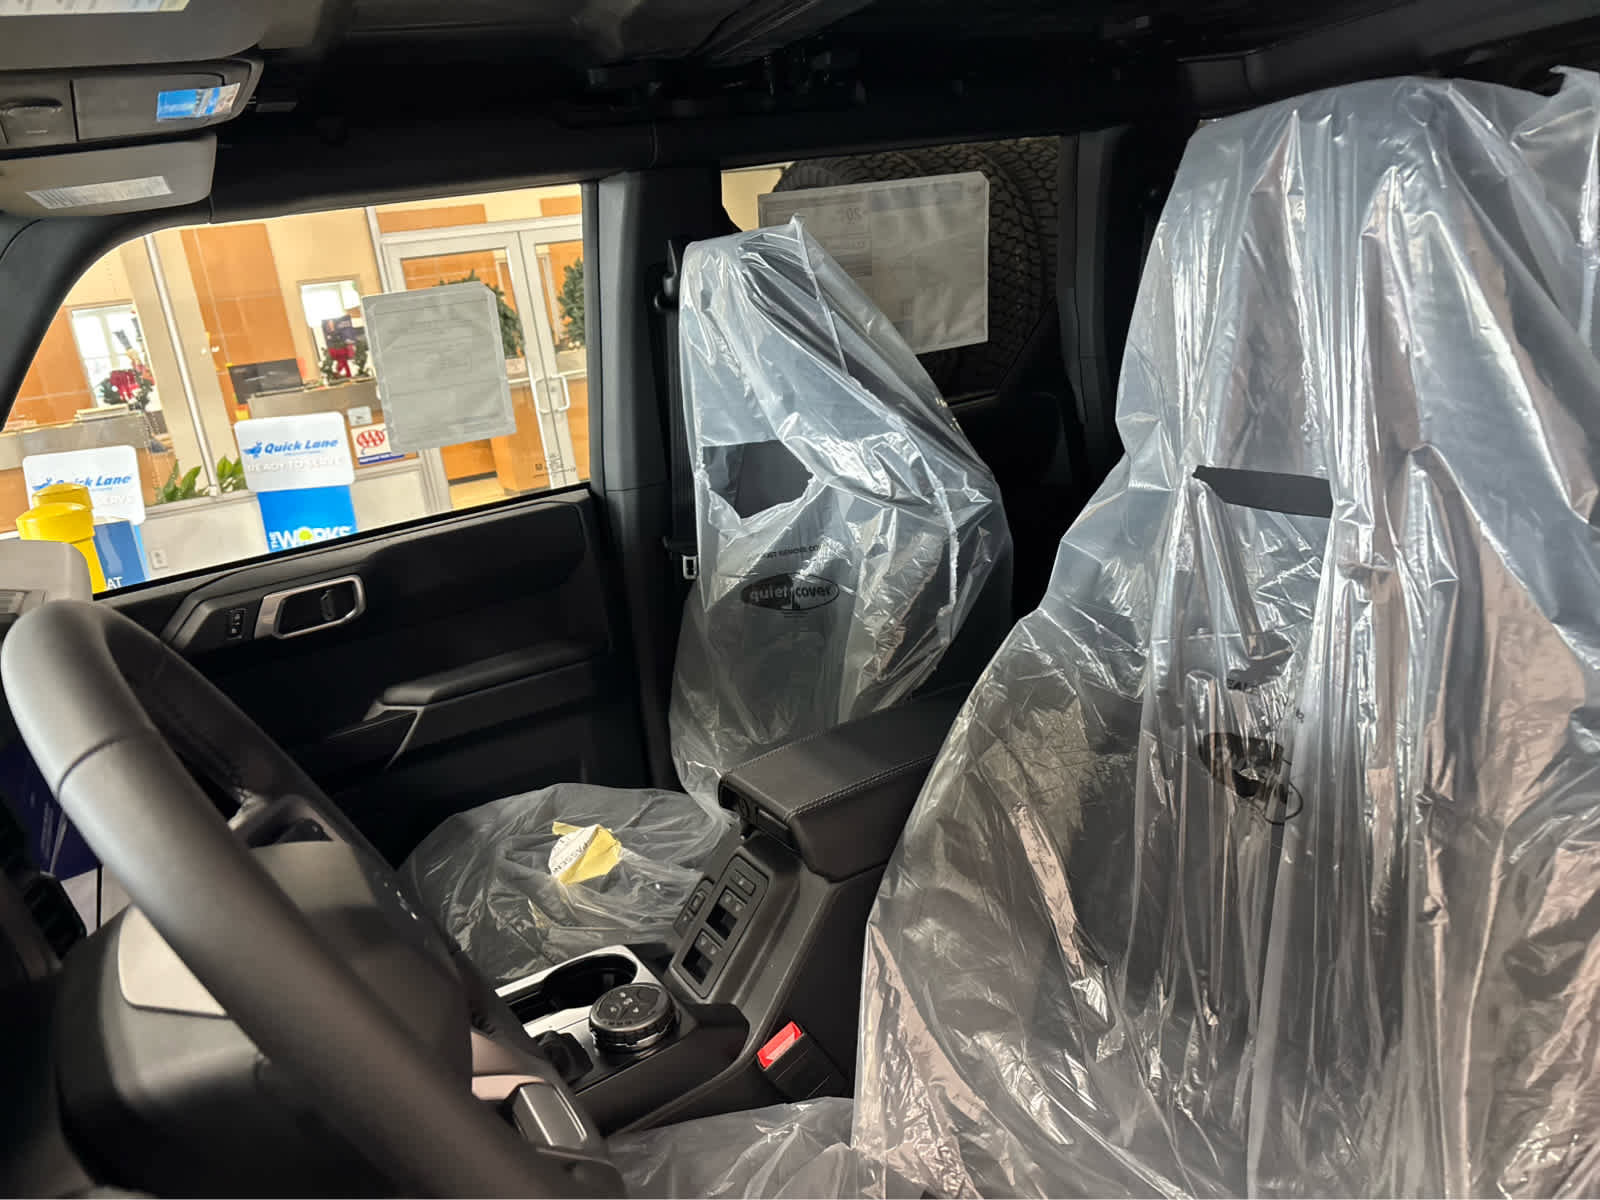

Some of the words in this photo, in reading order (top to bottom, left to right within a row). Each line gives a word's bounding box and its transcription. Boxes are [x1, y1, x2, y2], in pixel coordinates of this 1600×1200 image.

[264, 440, 302, 455] Quick
[304, 439, 338, 450] Lane
[95, 475, 132, 487] Lane
